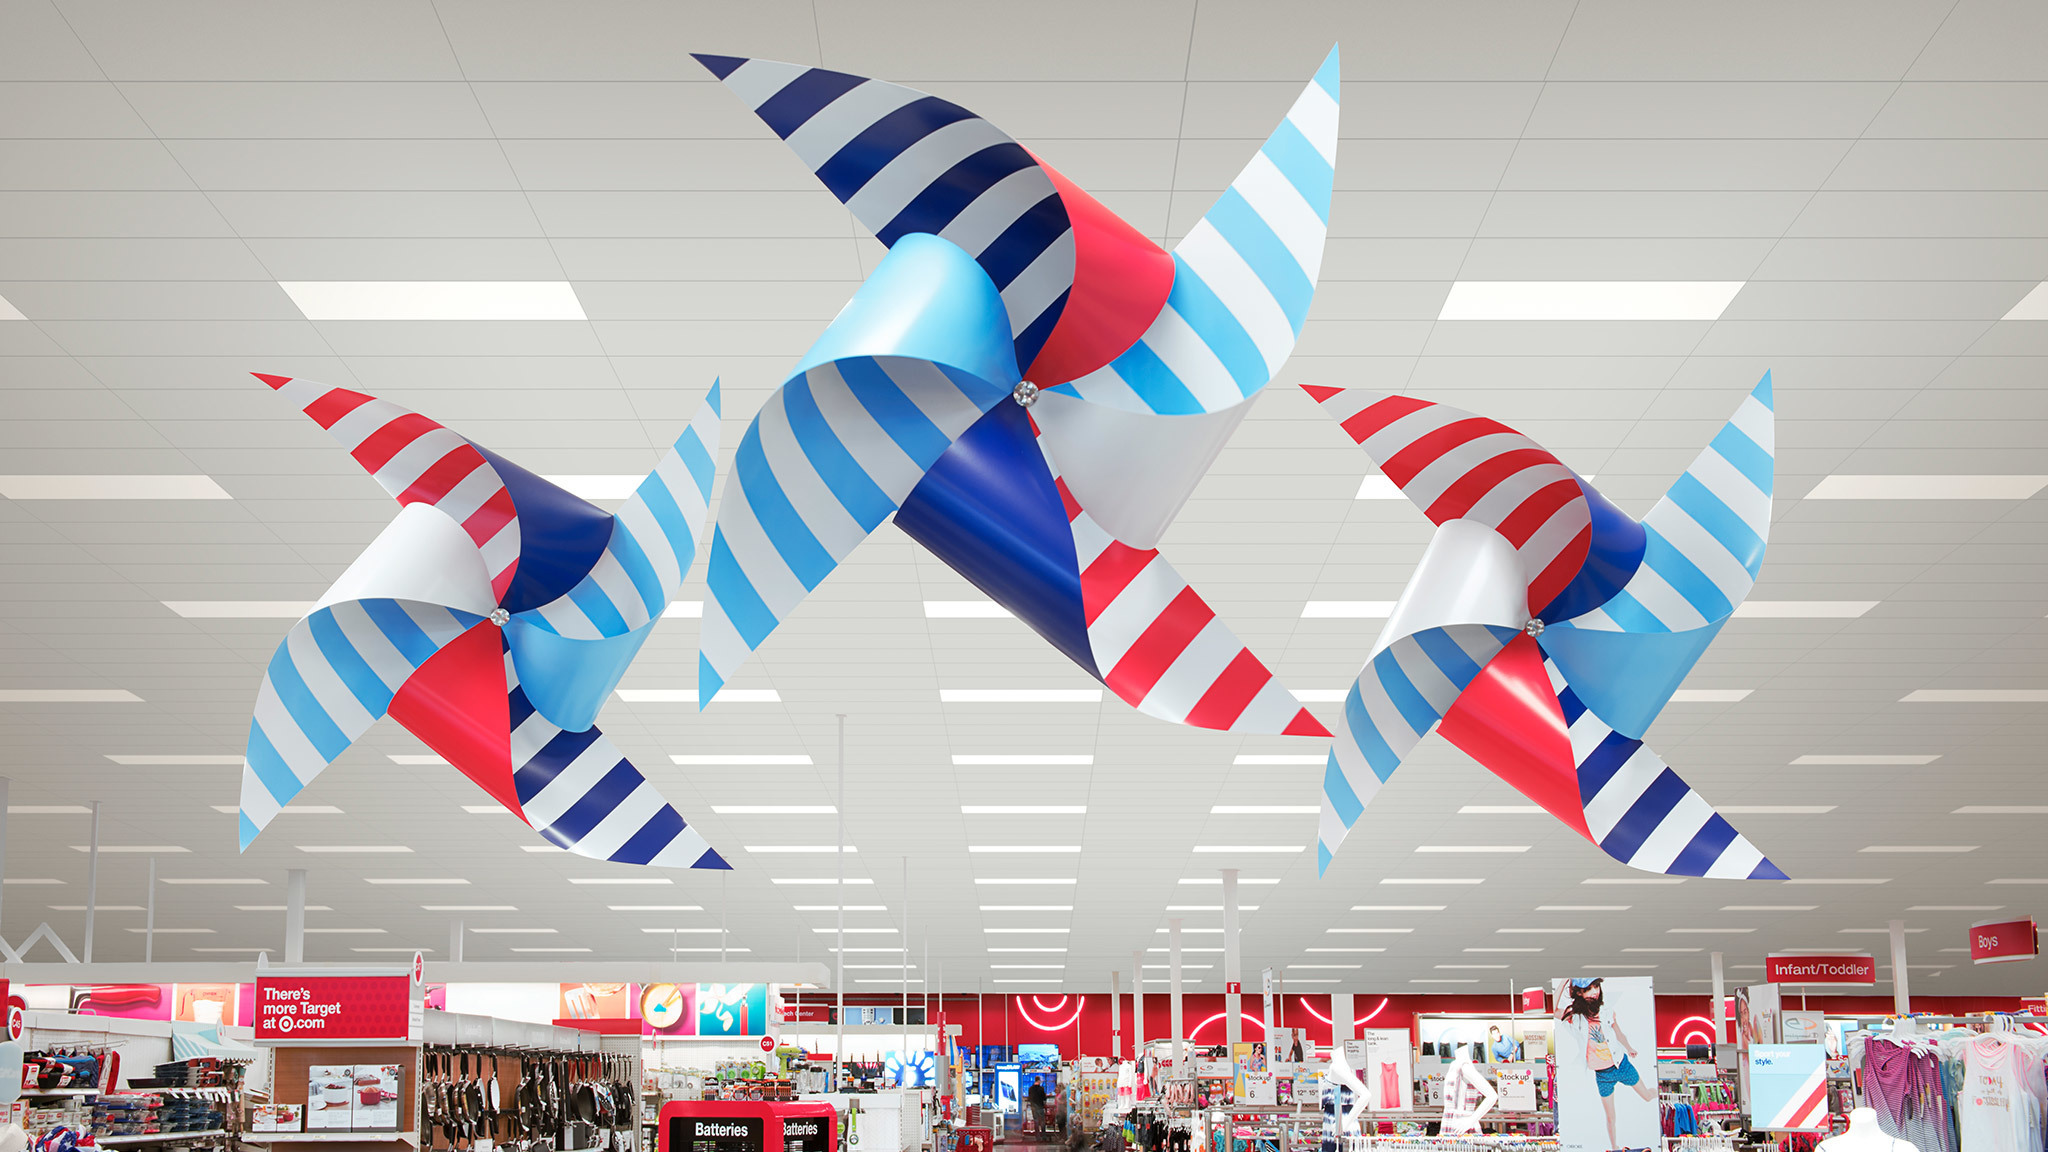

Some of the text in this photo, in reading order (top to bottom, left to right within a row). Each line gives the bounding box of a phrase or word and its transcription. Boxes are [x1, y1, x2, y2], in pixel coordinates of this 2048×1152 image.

[1978, 935, 1998, 950] Boys
[1775, 964, 1869, 975] Infant/Toddler
[263, 1001, 341, 1017] more Target
[263, 1017, 276, 1028] at
[1754, 1058, 1773, 1066] style.
[1432, 1091, 1439, 1099] 6
[695, 1122, 749, 1137] Batteries
